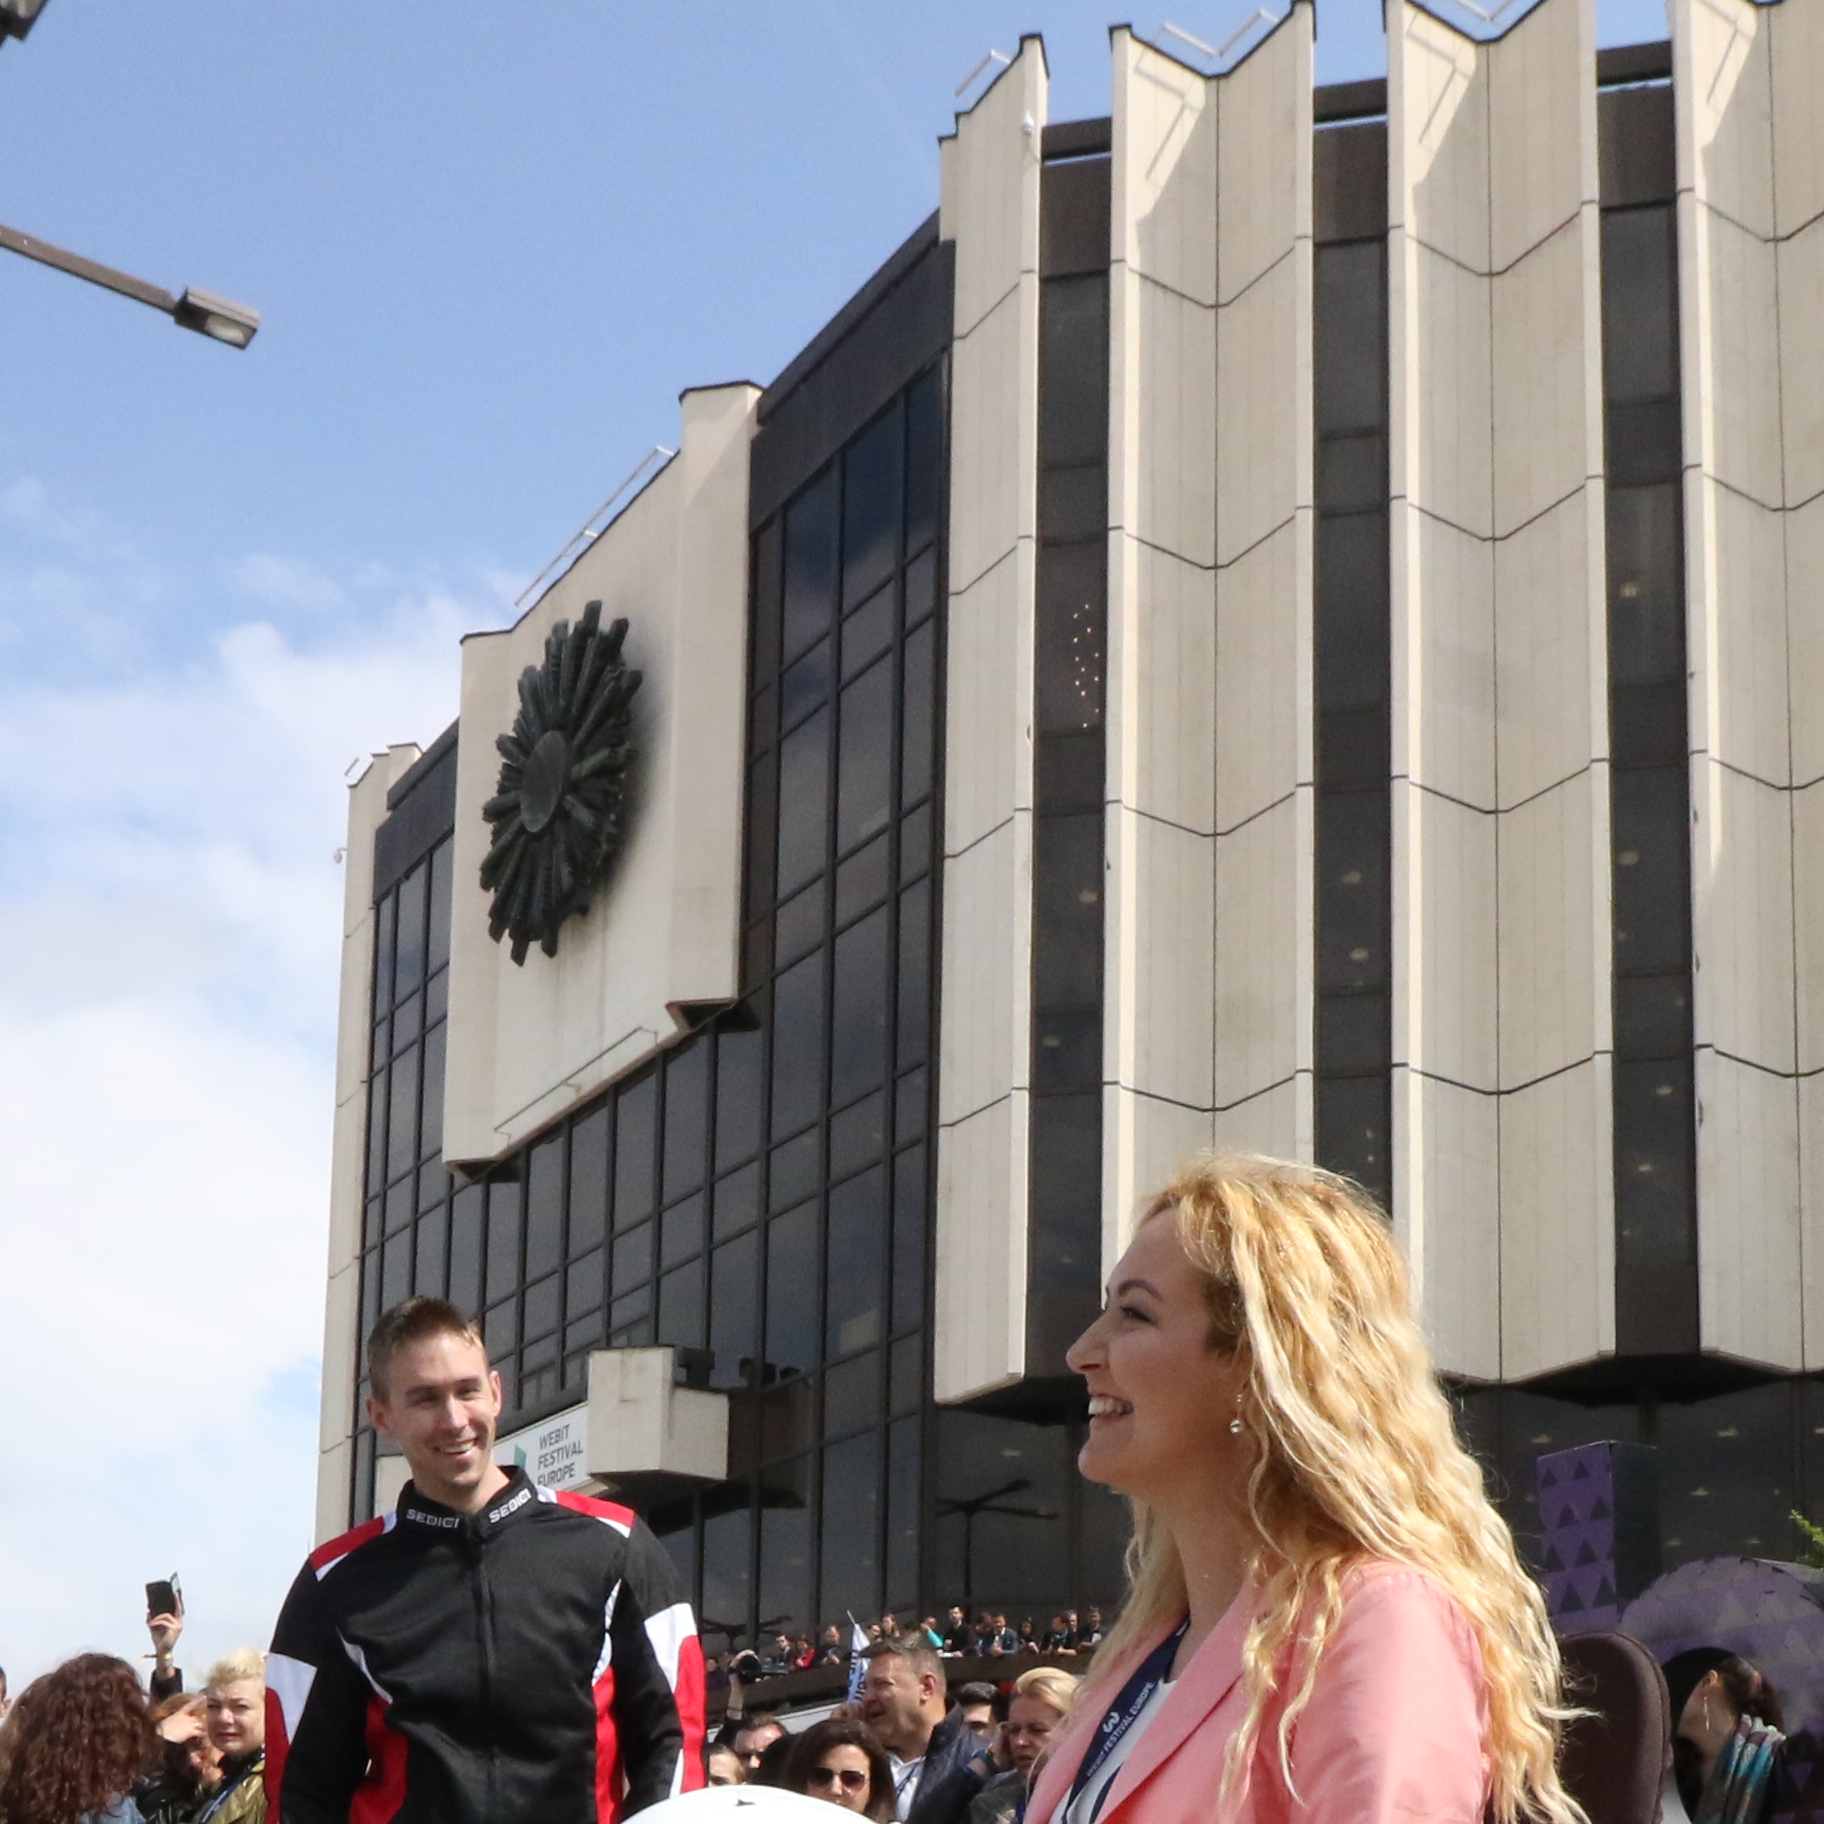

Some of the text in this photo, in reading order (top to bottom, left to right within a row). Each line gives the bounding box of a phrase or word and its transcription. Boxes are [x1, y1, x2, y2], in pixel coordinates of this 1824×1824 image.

[539, 1424, 571, 1450] WEBIT
[537, 1439, 584, 1471] FESTIVAL
[536, 1462, 576, 1487] EUROPE
[406, 1508, 460, 1529] SEDICI
[487, 1487, 533, 1524] SEDICI
[1102, 1705, 1136, 1751] FESTIVAL
[1130, 1681, 1157, 1716] EUROPE
